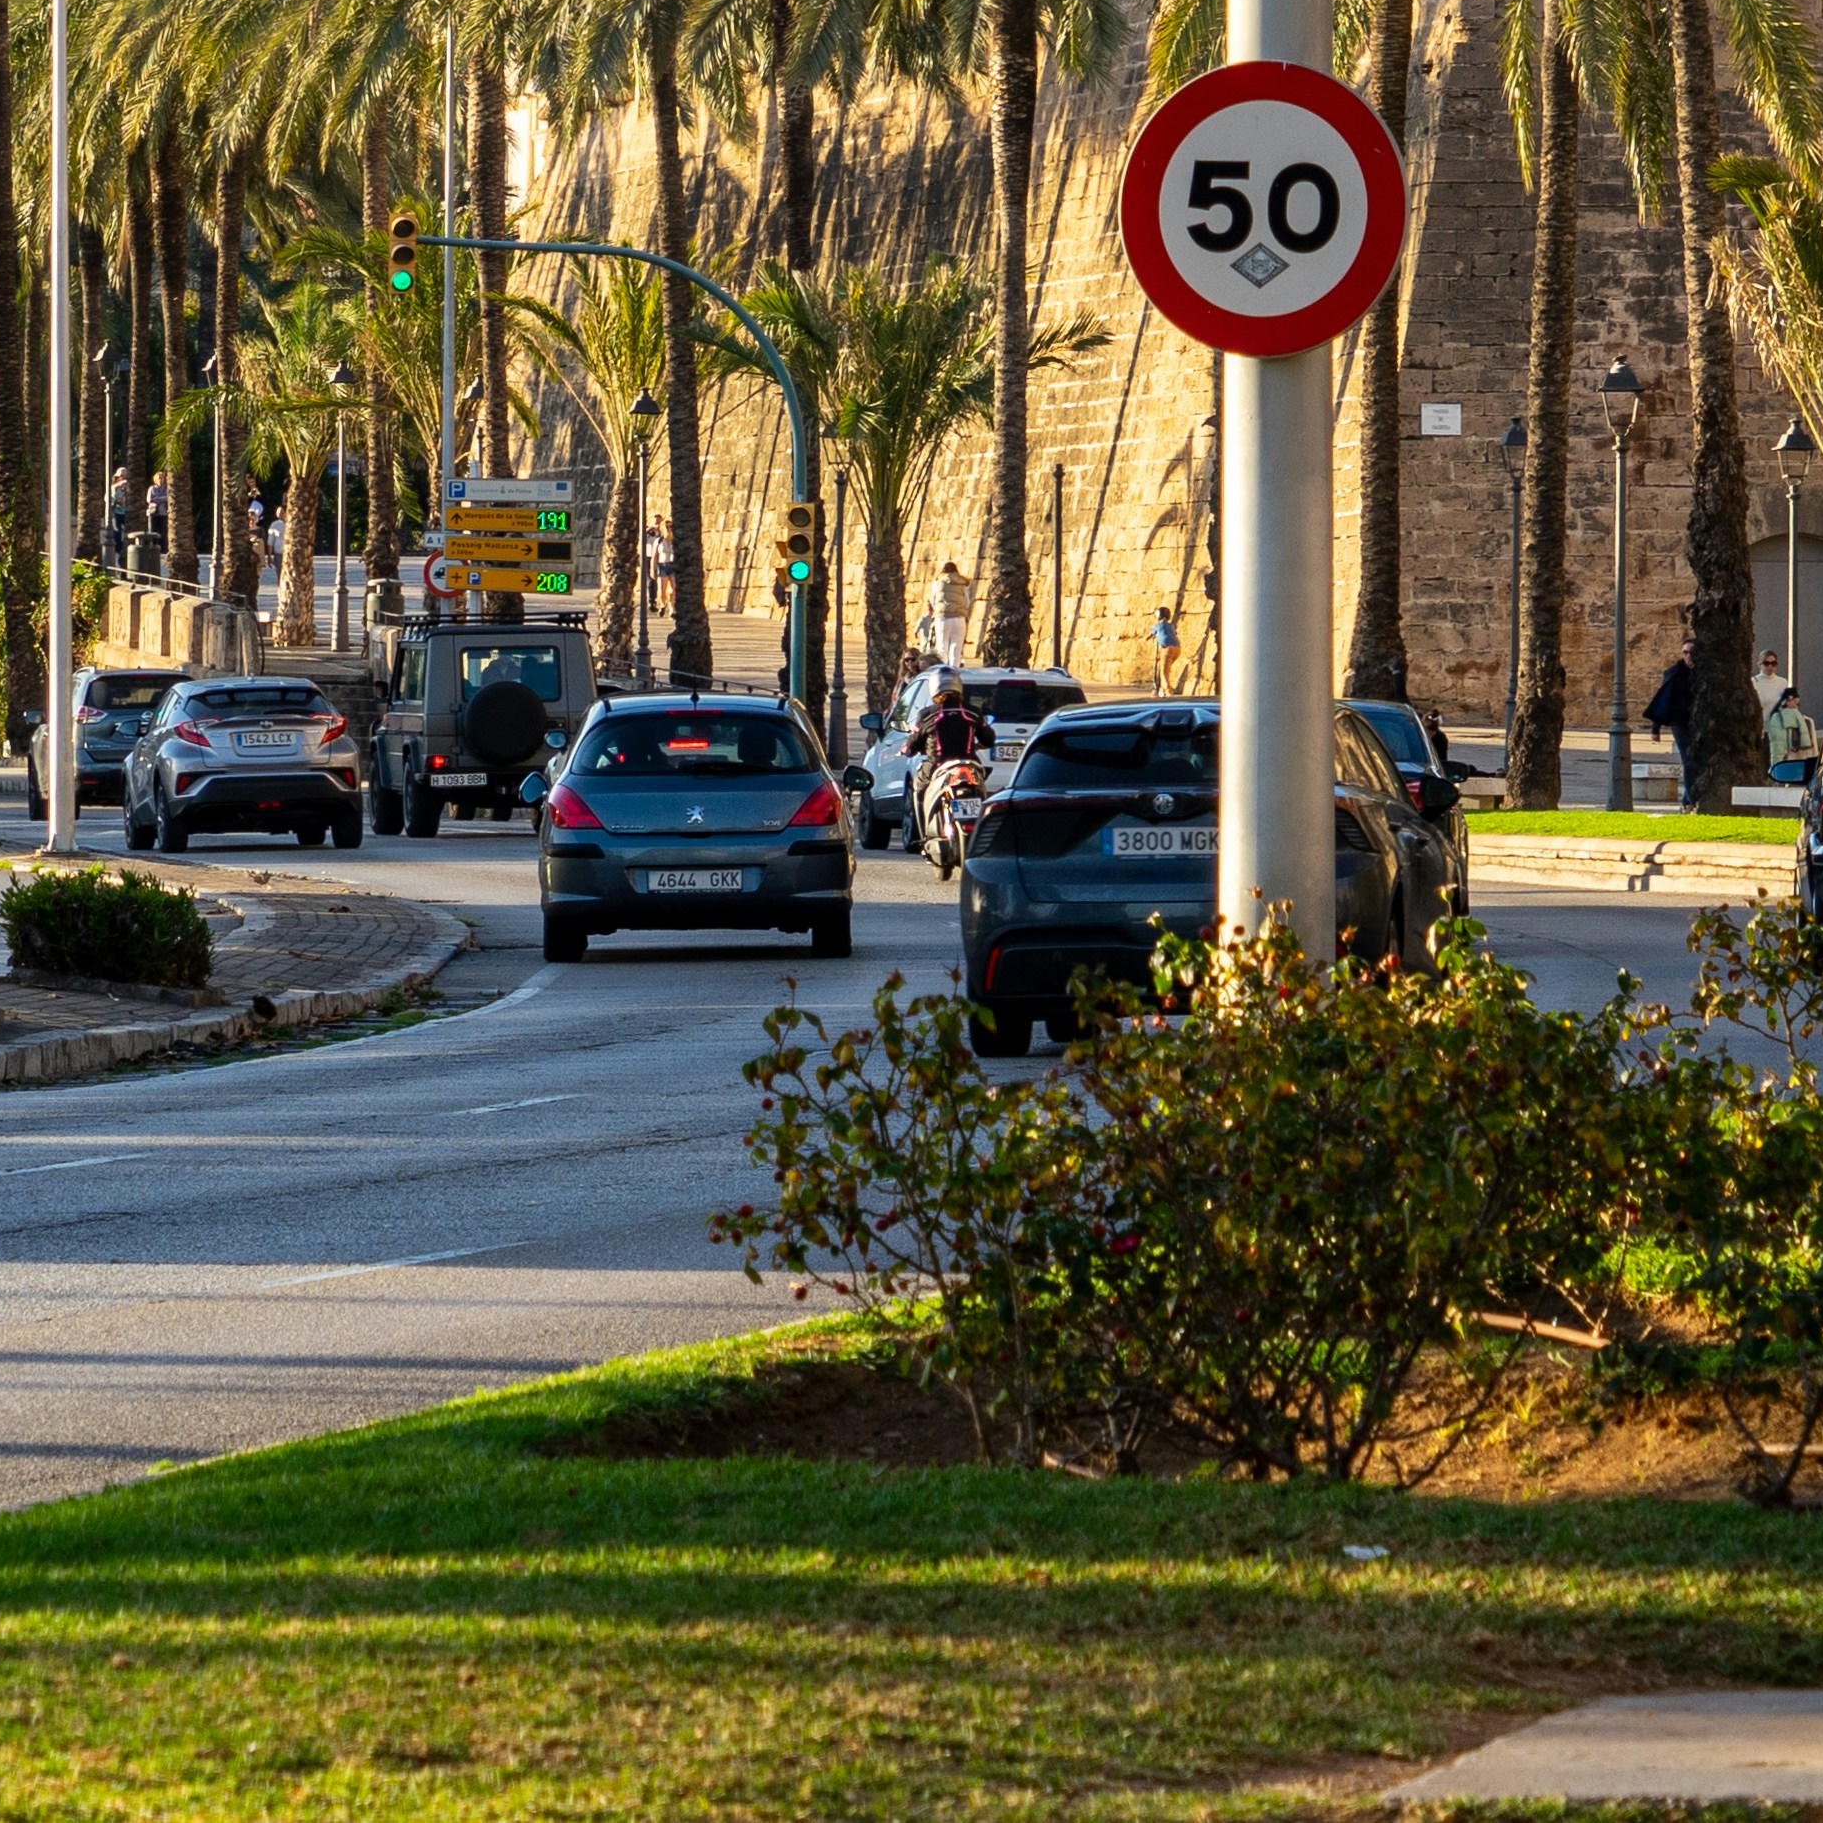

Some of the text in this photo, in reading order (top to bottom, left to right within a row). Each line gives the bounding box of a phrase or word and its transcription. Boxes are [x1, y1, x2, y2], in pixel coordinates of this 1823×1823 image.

[1186, 160, 1340, 254] 50
[537, 511, 567, 531] 191
[536, 573, 568, 592] 208
[244, 733, 293, 744] 1542 LCX
[442, 775, 465, 785] 1093
[1118, 831, 1220, 851] 3800 MGK
[657, 871, 740, 888] 4644 GKK
